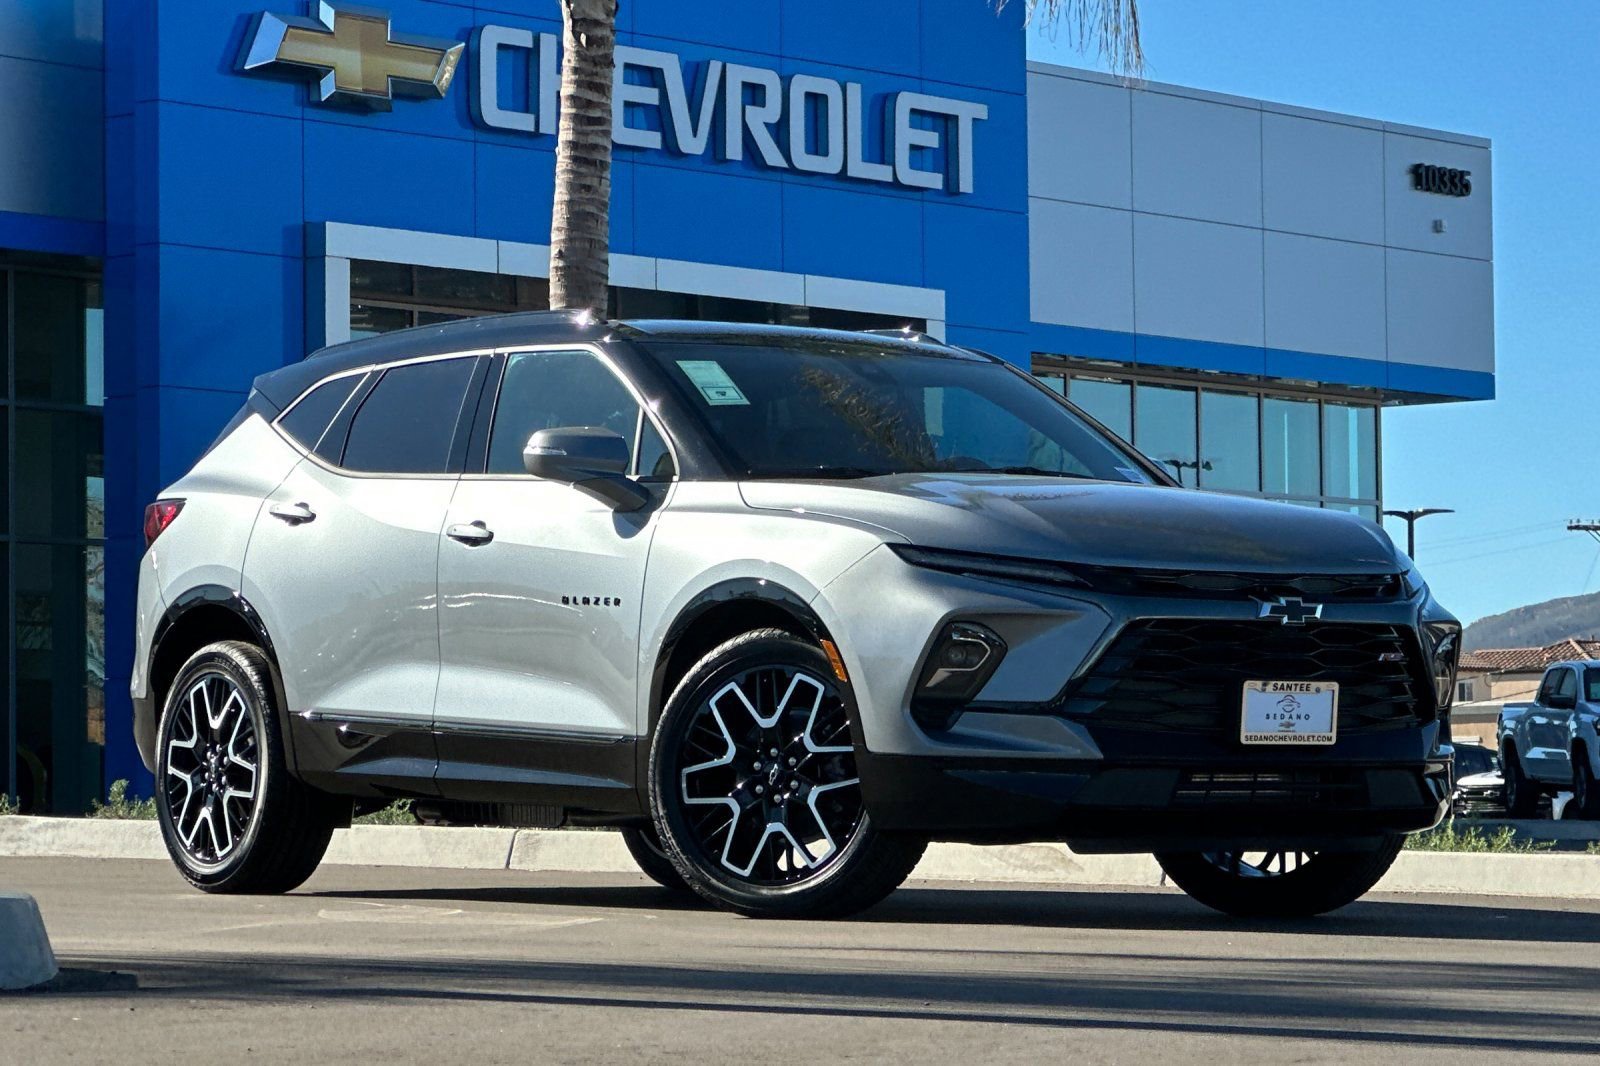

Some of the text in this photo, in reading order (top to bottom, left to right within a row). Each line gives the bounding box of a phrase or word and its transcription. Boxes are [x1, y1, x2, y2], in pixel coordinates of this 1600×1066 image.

[561, 595, 621, 607] BLAZER
[1272, 682, 1312, 692] SANTEE
[1265, 713, 1311, 721] SEDANO
[1244, 734, 1333, 743] SEDANOCHEVROLET.COM
